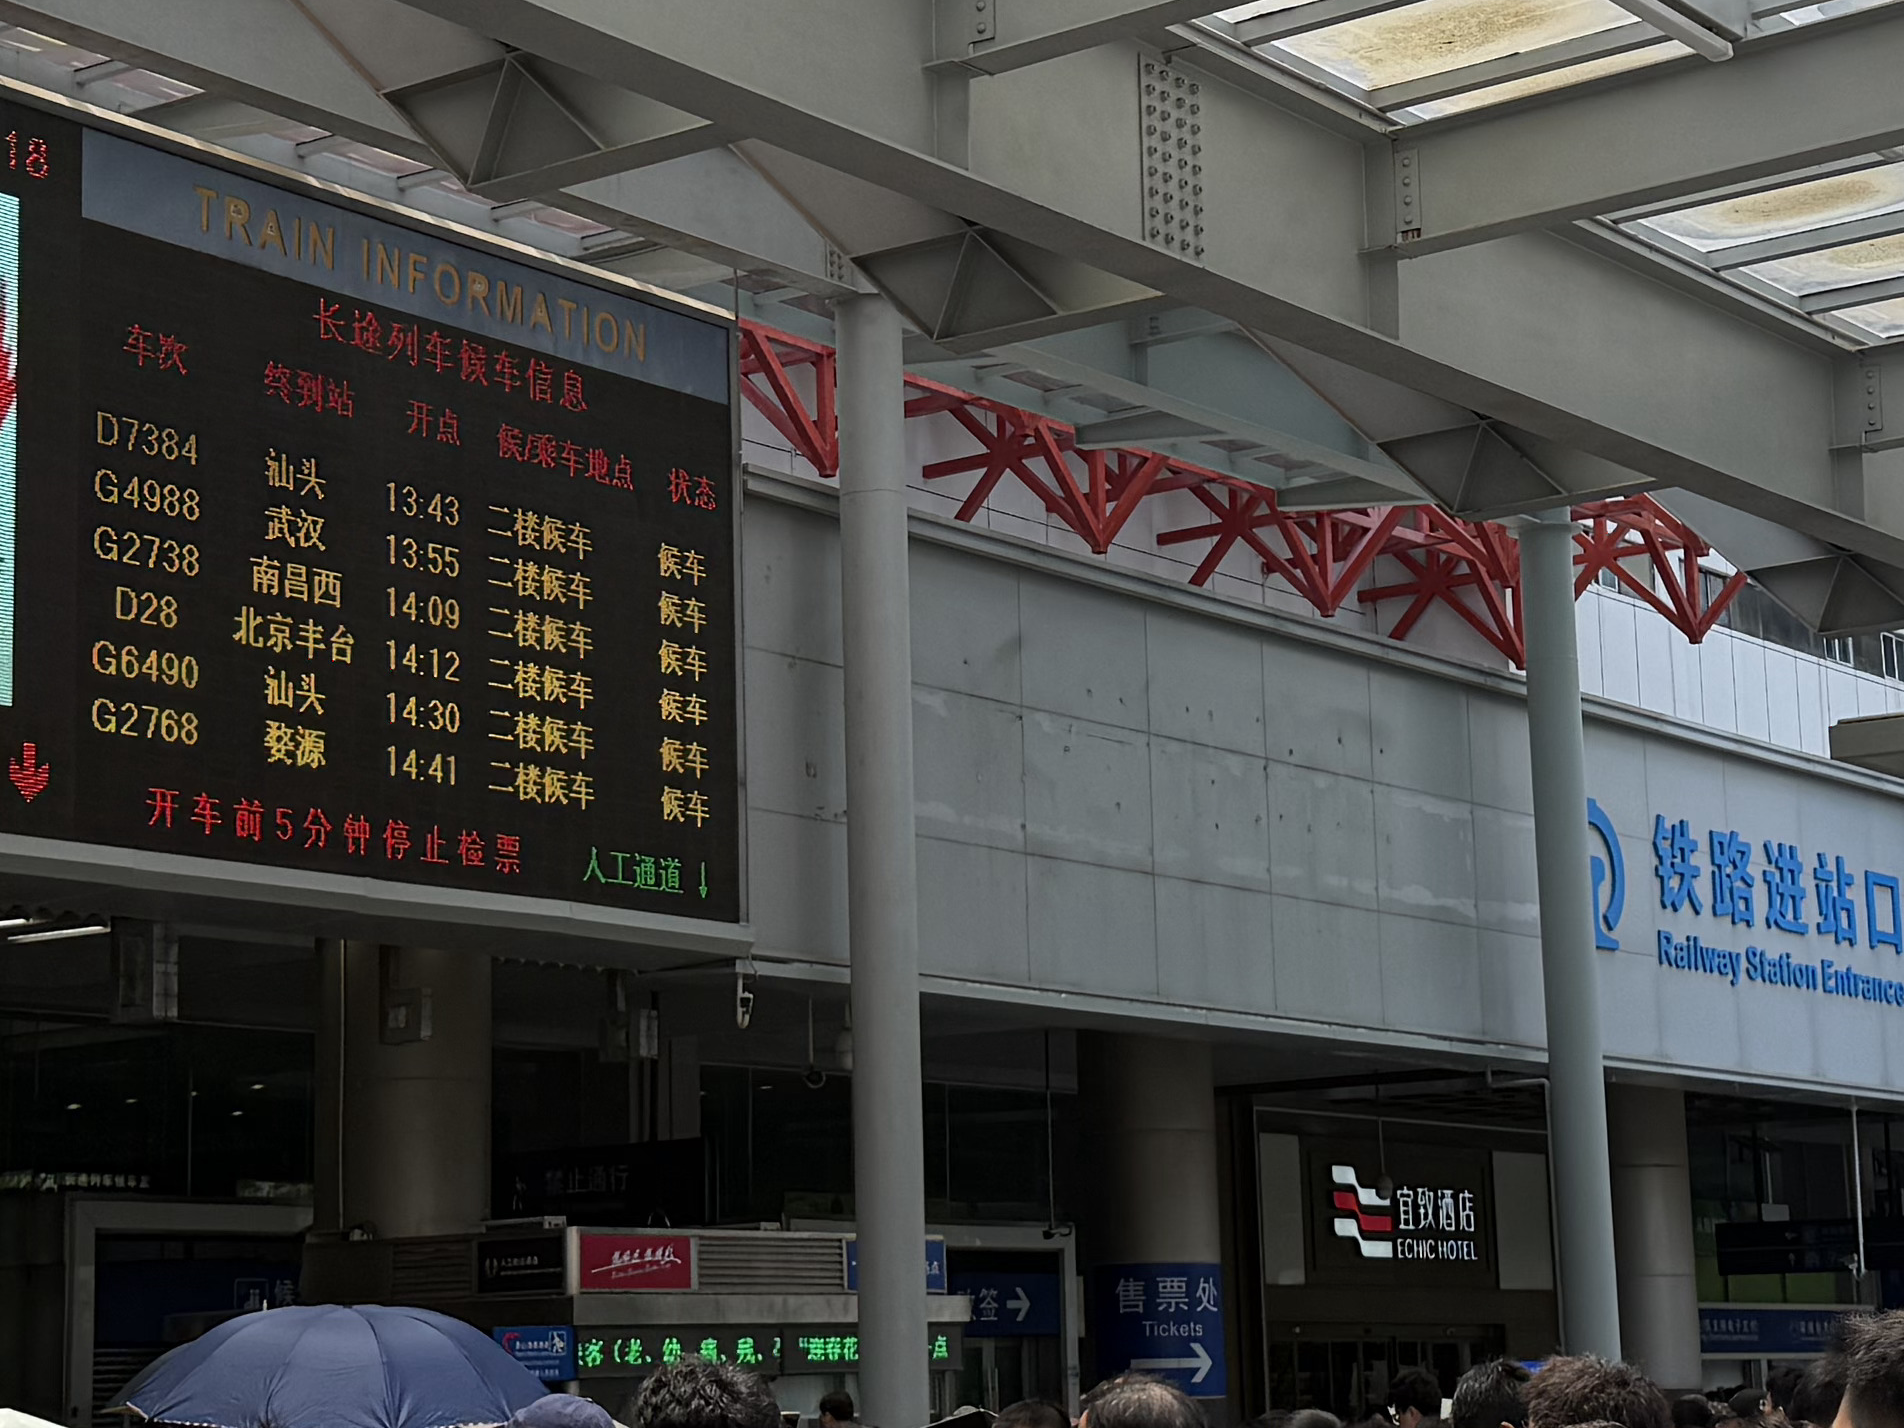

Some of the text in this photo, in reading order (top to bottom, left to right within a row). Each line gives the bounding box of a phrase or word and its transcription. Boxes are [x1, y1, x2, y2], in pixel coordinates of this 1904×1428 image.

[194, 184, 648, 362] TRAIN INFORMATION
[122, 322, 189, 375] 车次
[263, 360, 356, 419] 终到站
[405, 398, 462, 447] 开点
[667, 466, 718, 512] 状态
[312, 297, 589, 412] 长途列车候车信息
[94, 468, 708, 633] G4988 武汉 13:55 二楼候车 候车
[96, 410, 708, 585] D7384 汕头 13:43 二楼候车 候车
[93, 526, 708, 681] G2738 南昌西 14:09 二楼候车 候车
[114, 585, 709, 727] D28 北京丰台 14:12 二楼候车 候车
[91, 640, 709, 779] G6490 汕头 14:30 二楼候车 候车
[91, 697, 711, 828] G2768 婺源 14:41 二楼候车 候车
[146, 787, 522, 875] 开车前5分钟停止检票
[582, 845, 684, 896] 人工通道
[1652, 813, 1904, 955] 铁路进站口
[1657, 929, 1741, 988] Railway
[1746, 945, 1818, 992] Station
[1397, 1185, 1475, 1234] 宜致酒店
[1397, 1237, 1479, 1262] ECHIC HOTEL
[1115, 1275, 1219, 1315] 售票处
[1142, 1319, 1204, 1338] Tickets
